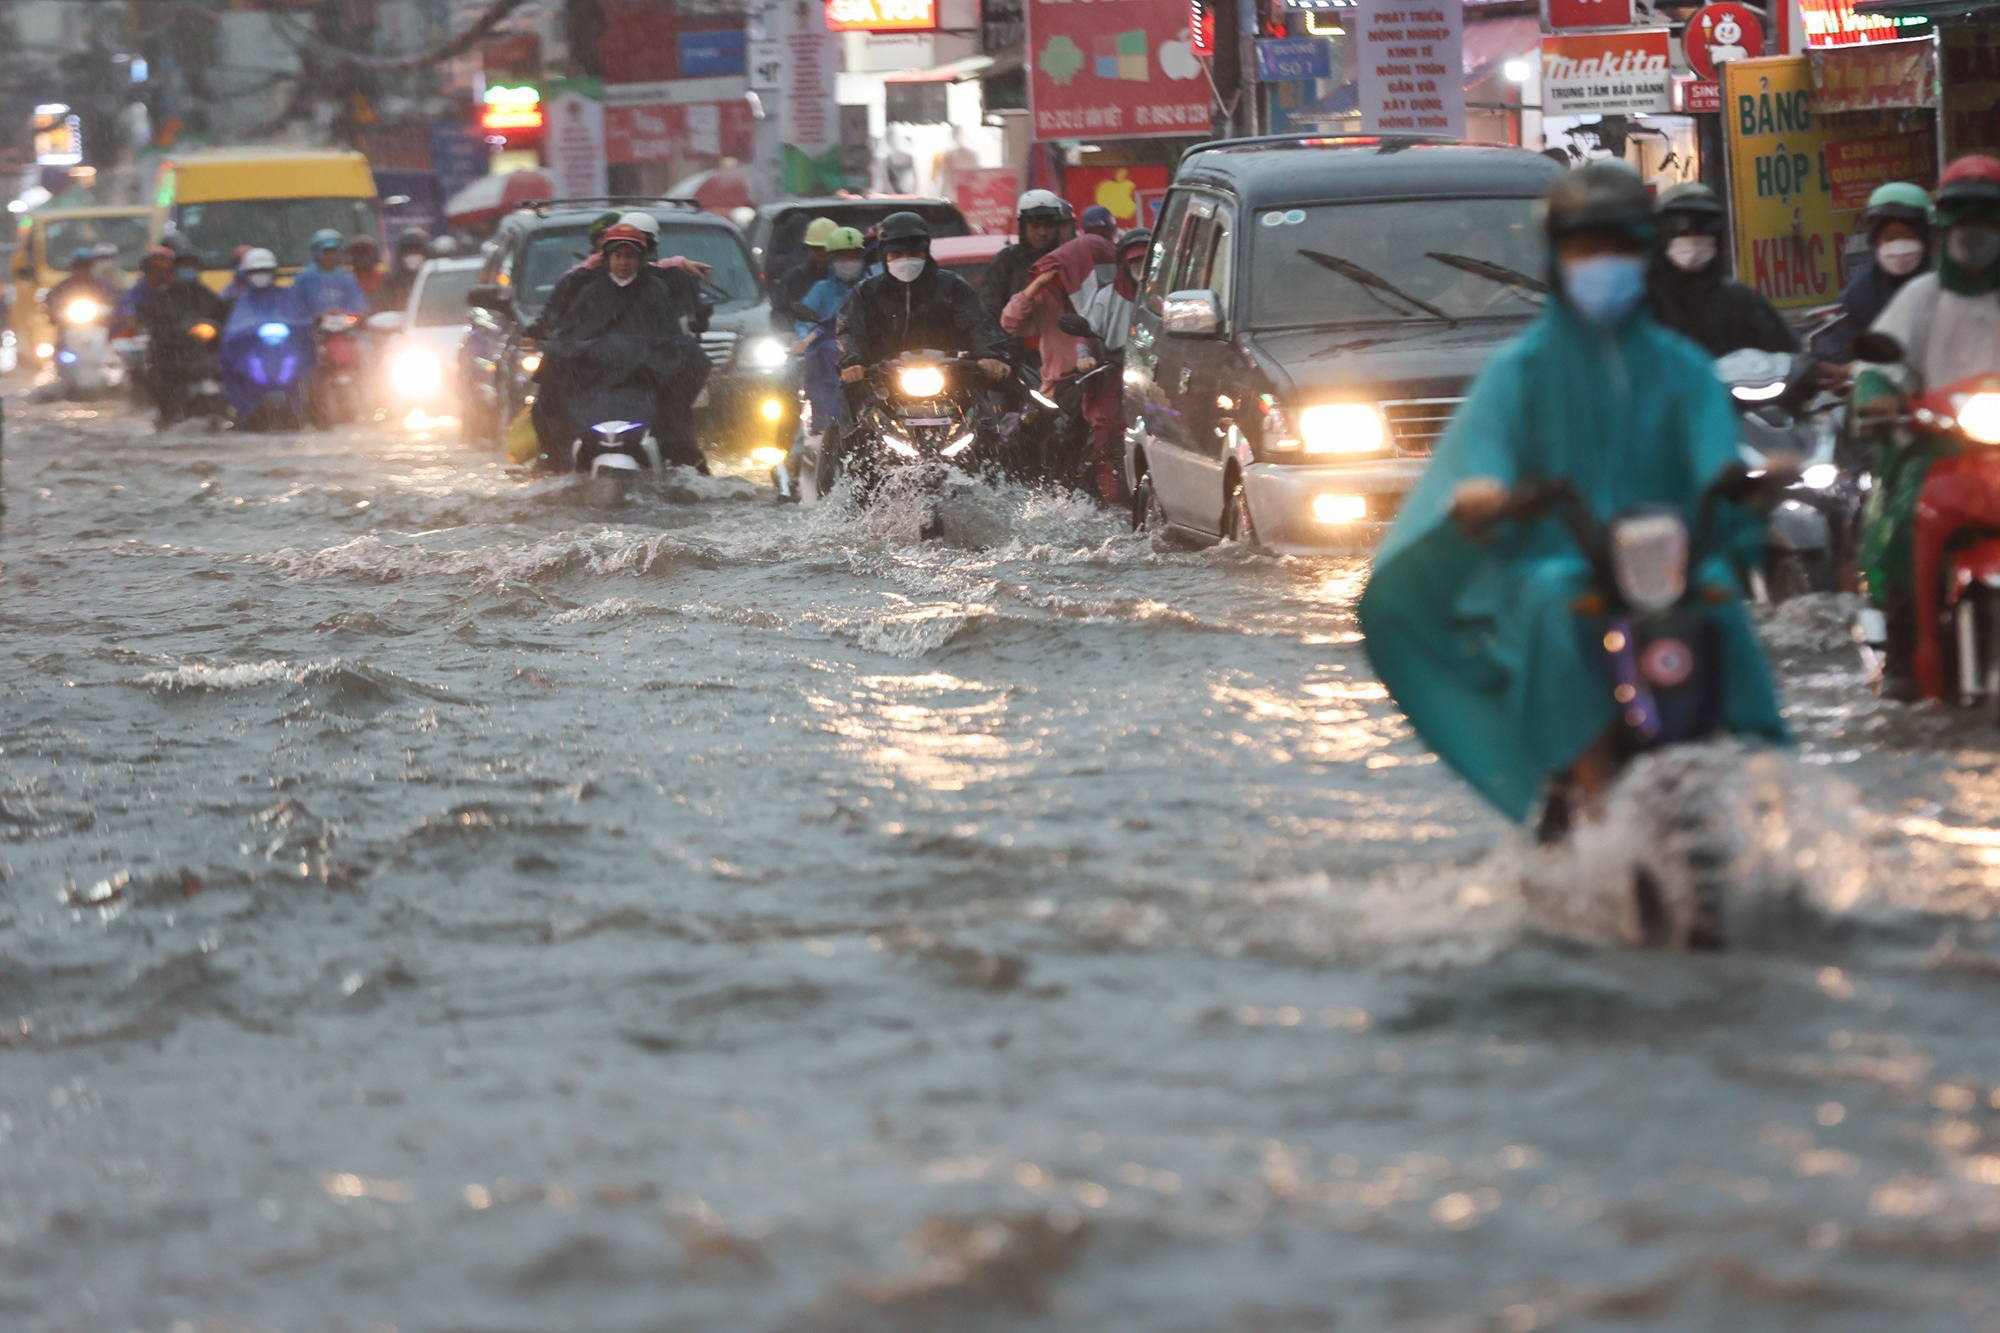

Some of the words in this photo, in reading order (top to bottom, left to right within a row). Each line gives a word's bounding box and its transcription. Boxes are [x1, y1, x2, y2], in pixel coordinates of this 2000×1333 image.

[1306, 61, 1313, 75] 1
[1551, 86, 1584, 99] TRUNG
[1588, 83, 1609, 97] TÂM
[1613, 81, 1633, 96] BẢO
[1636, 80, 1664, 95] HÀNH
[1630, 99, 1654, 107] CENTER
[1739, 76, 1810, 136] BẢNG
[1755, 143, 1810, 206] HỘP
